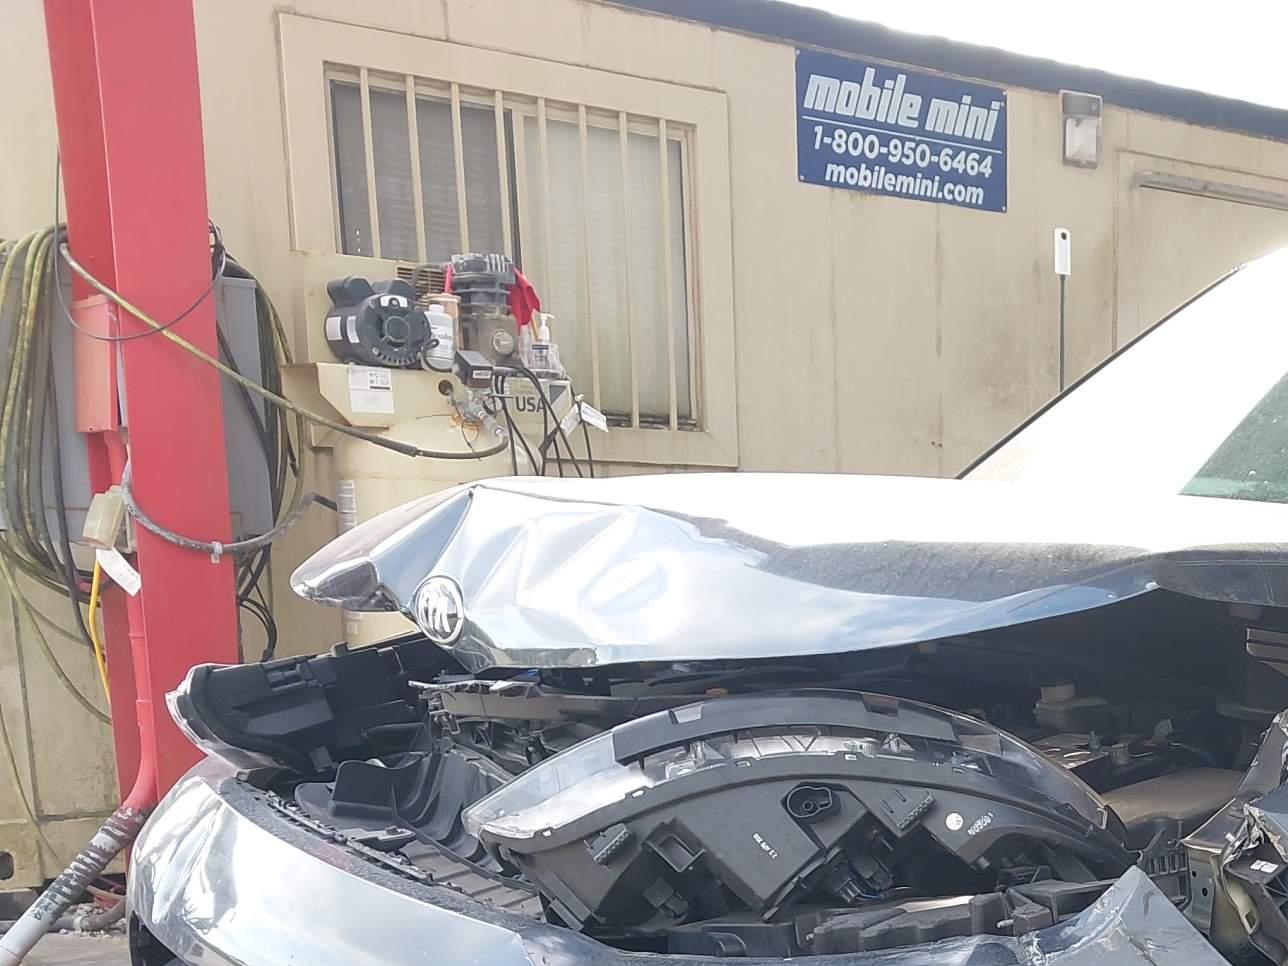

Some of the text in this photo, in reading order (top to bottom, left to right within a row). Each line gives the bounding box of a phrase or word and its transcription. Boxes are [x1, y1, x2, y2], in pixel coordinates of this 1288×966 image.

[803, 67, 1000, 142] mobile mini
[813, 125, 993, 178] 1-800-950-6464
[825, 163, 985, 205] mobilemini.com
